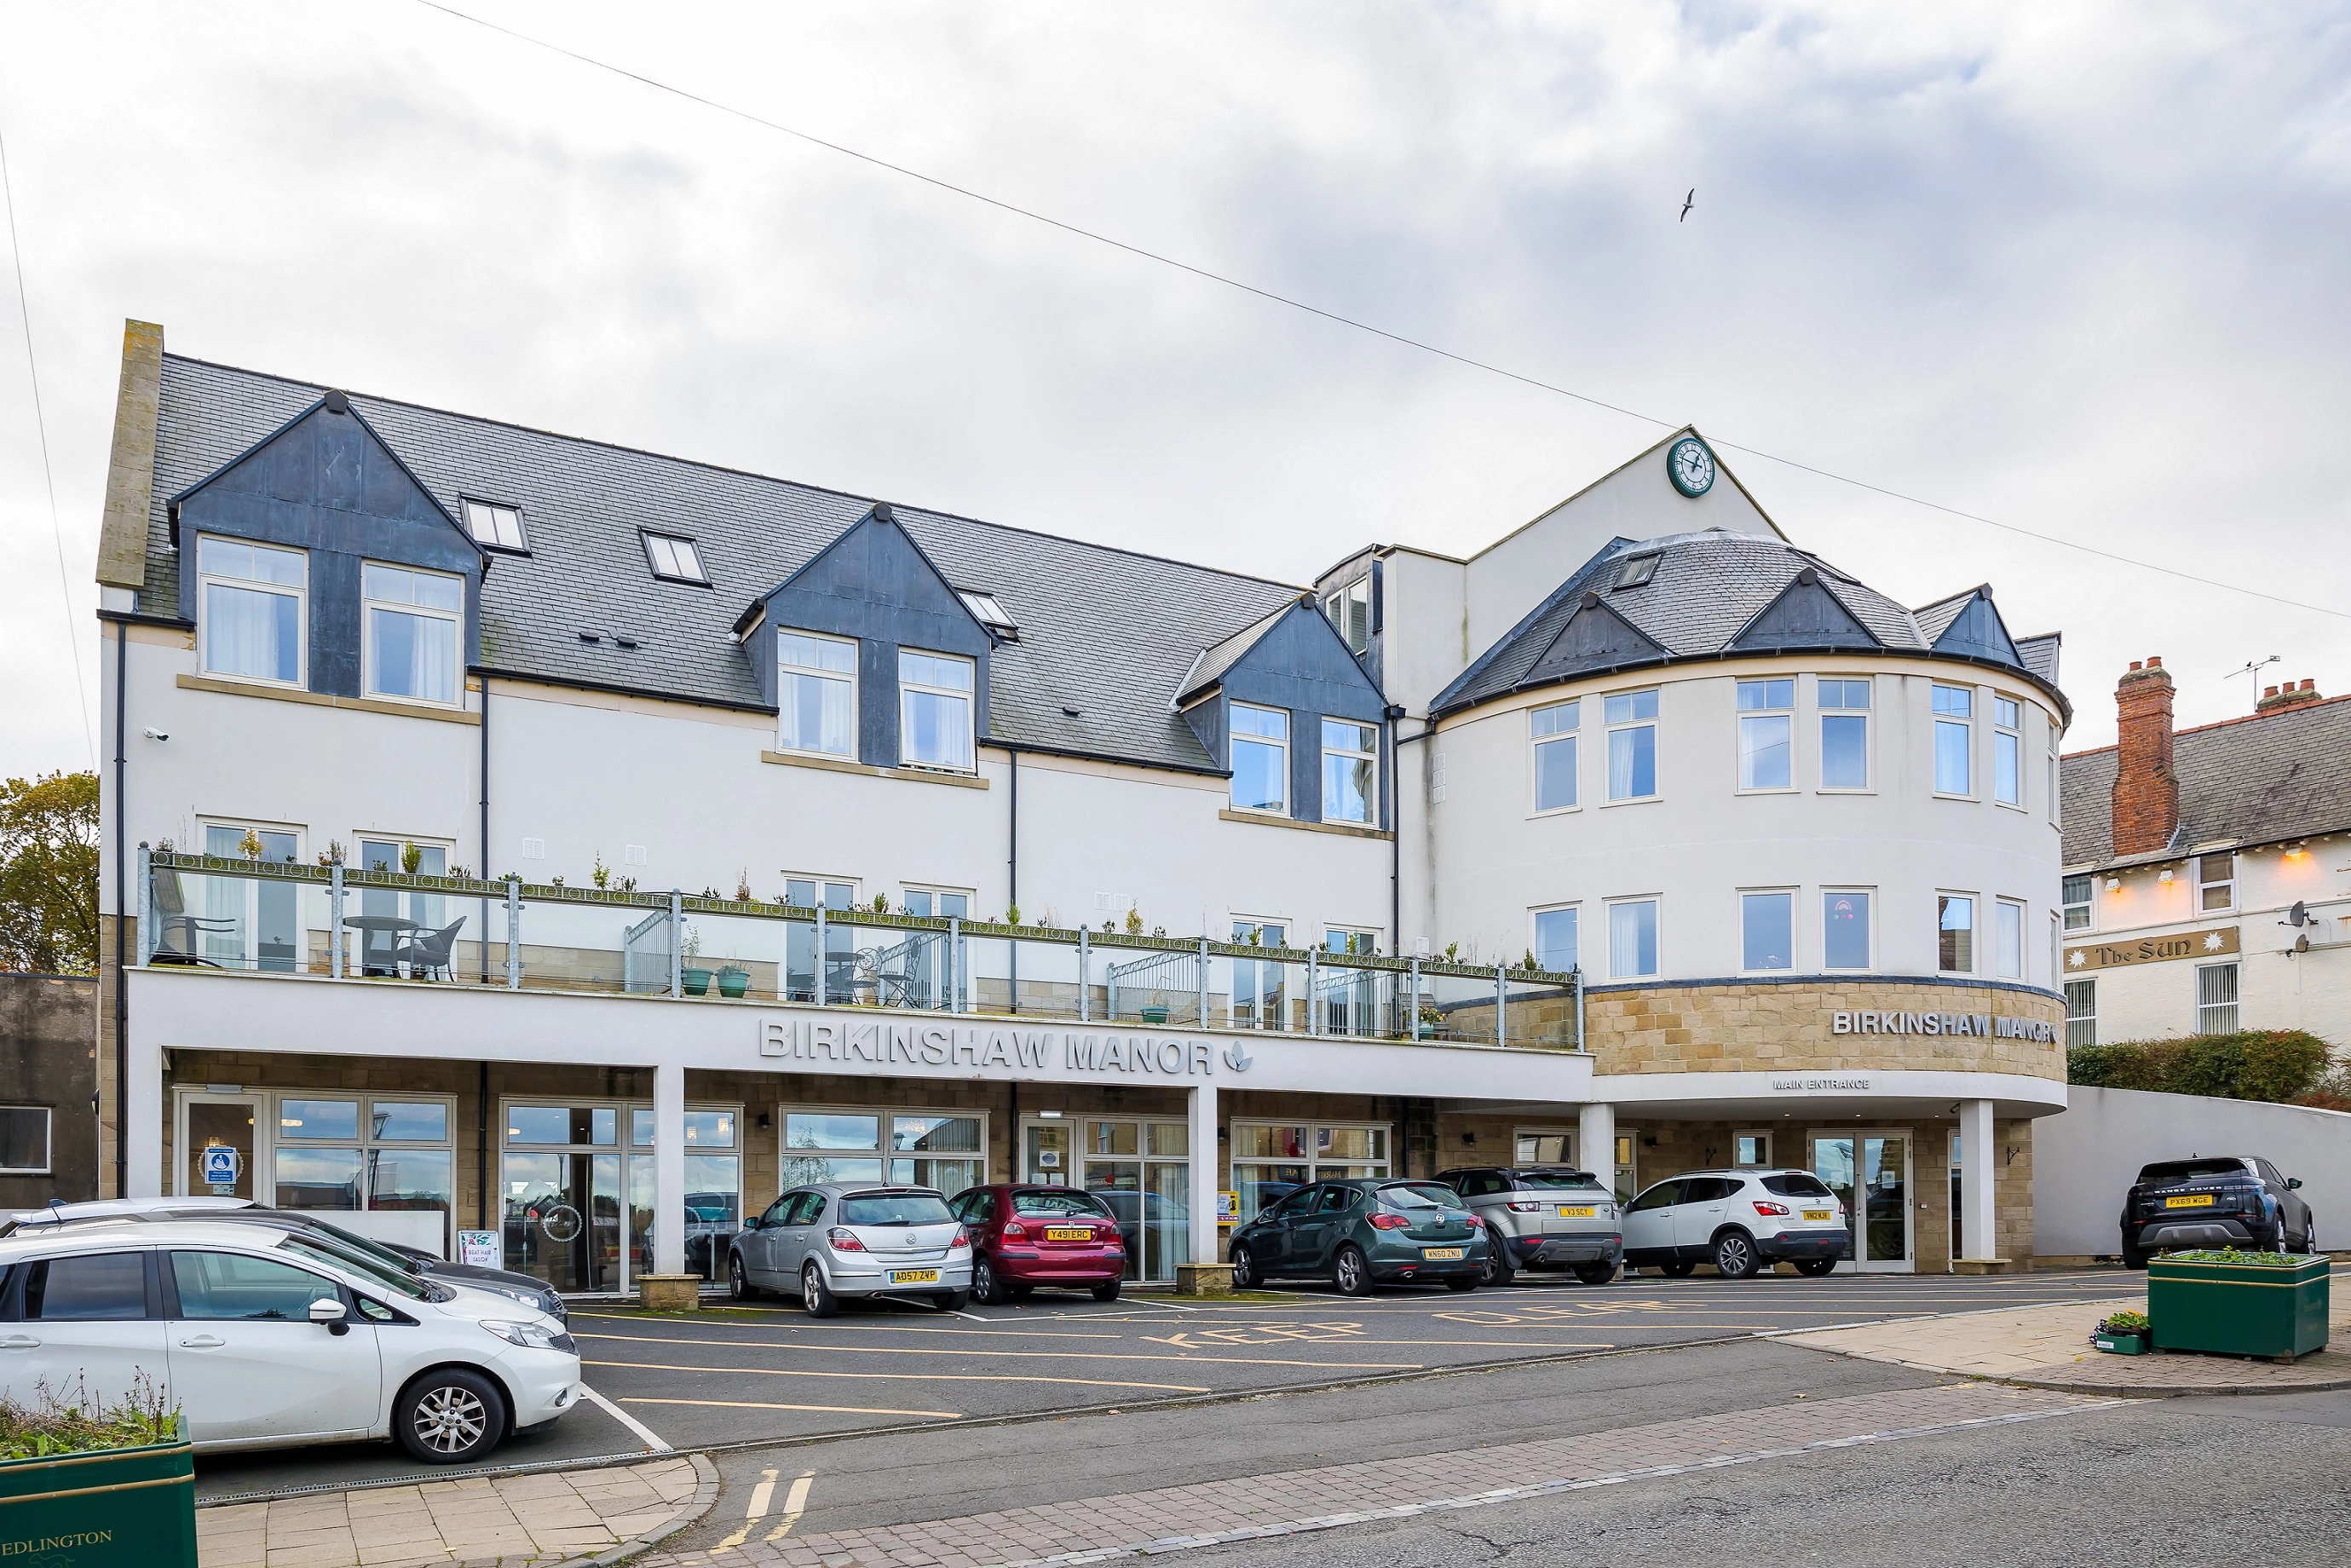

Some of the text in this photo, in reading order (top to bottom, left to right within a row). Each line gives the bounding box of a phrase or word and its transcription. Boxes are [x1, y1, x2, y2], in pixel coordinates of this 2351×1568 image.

[2095, 948, 2134, 965] The
[1833, 1012, 2051, 1042] BIRKINSHAW MANOR
[759, 1019, 1214, 1074] BIRKINSHAW MANOR
[1773, 1080, 1870, 1089] MAIN ENTRANCE
[896, 1271, 918, 1281] AD57
[1139, 1300, 1677, 1349] KEEP CLEAR
